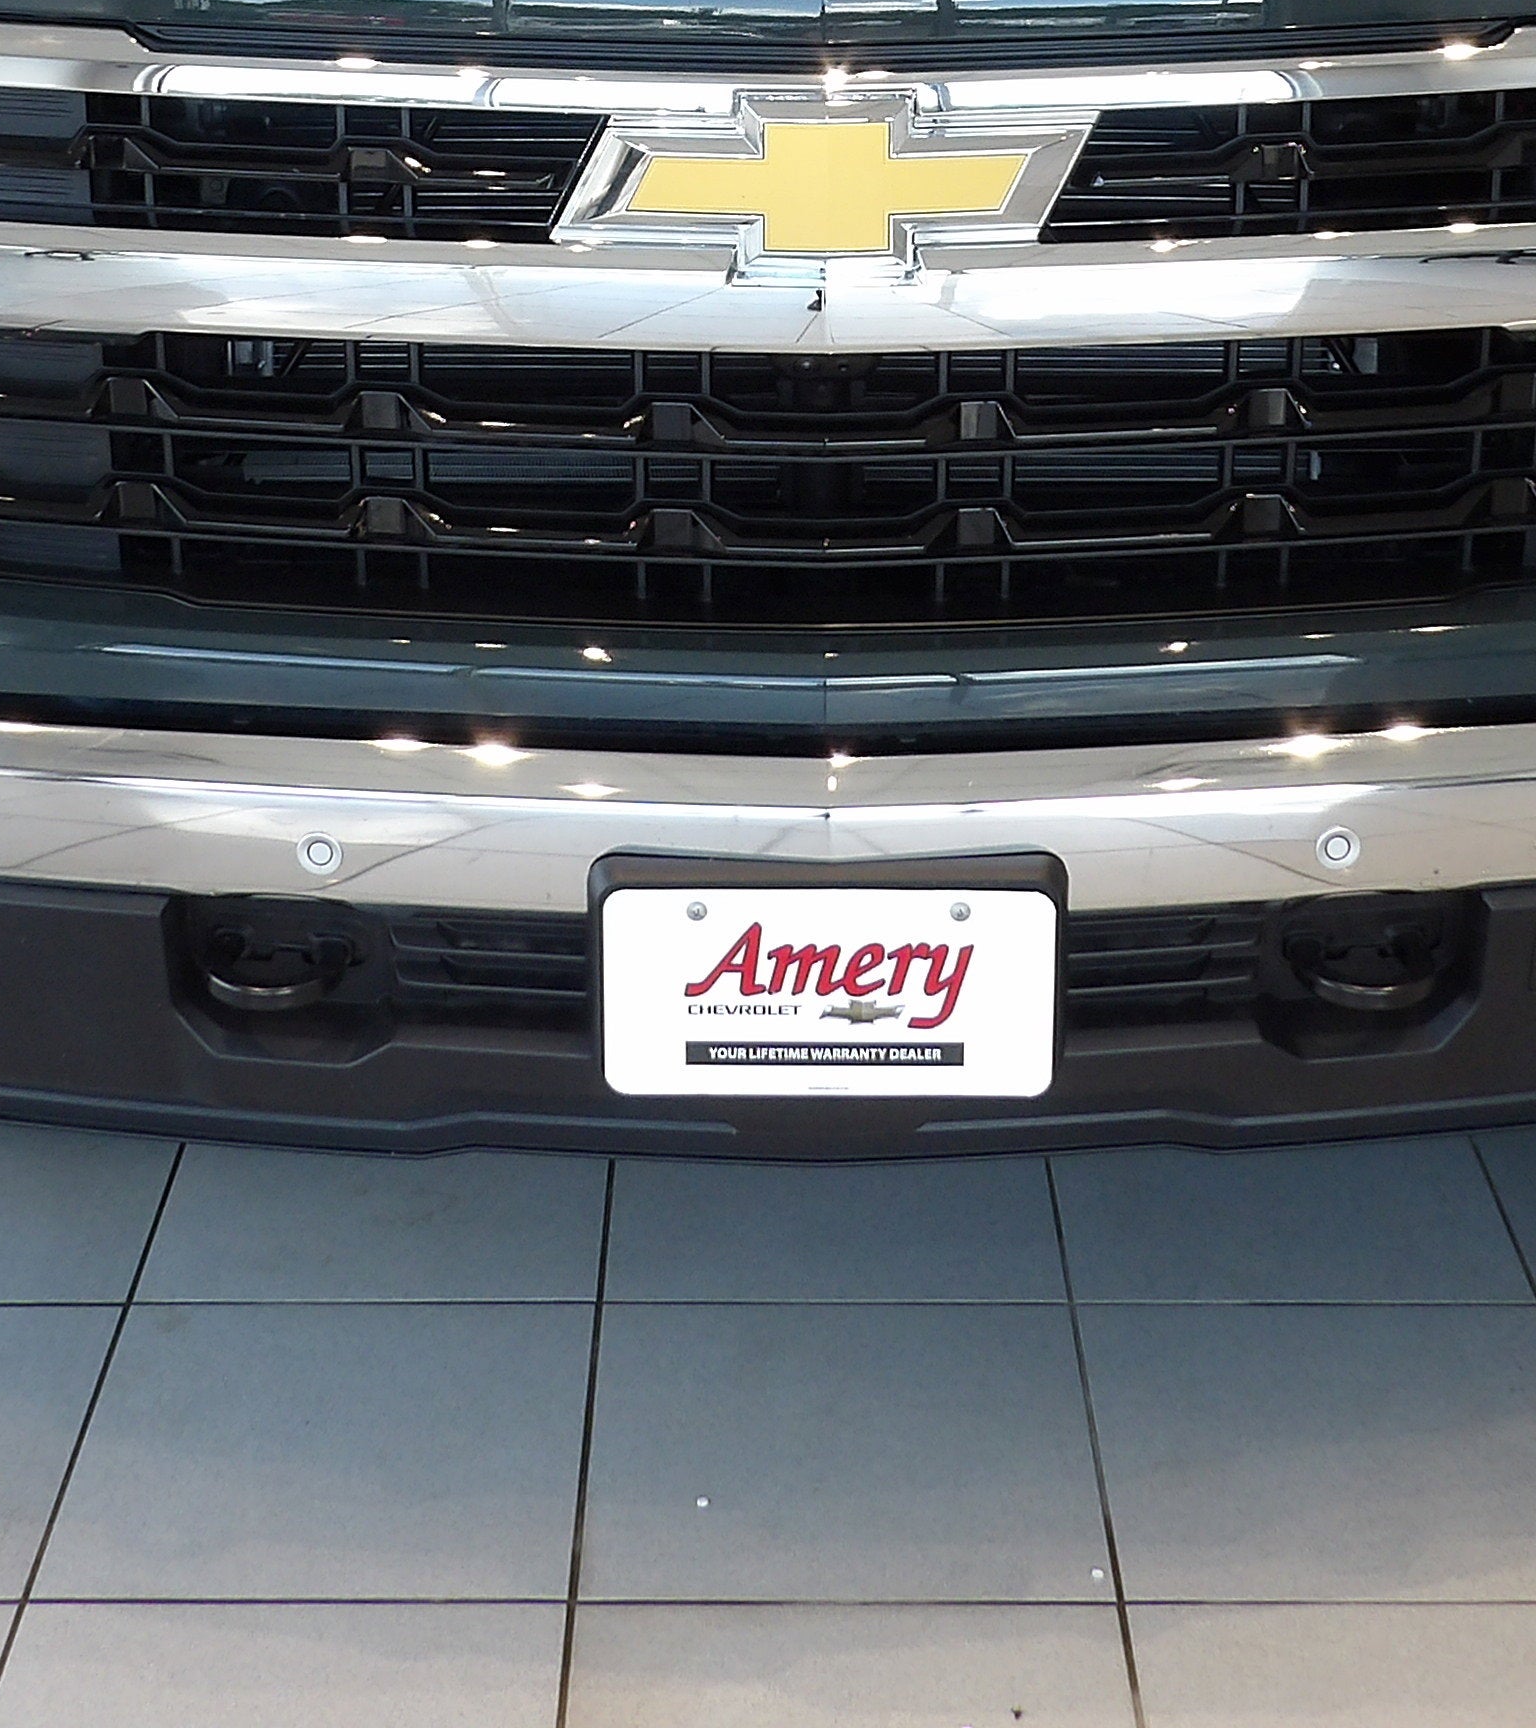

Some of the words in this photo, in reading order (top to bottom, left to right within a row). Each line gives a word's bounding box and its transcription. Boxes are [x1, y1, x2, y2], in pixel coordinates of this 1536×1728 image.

[684, 921, 974, 1030] Amery
[687, 1004, 802, 1016] CHEVROLET
[709, 1046, 747, 1060] YOUR
[748, 1046, 809, 1060] LIFETIME
[810, 1047, 887, 1060] WARRANTY
[889, 1047, 942, 1061] DEALER
